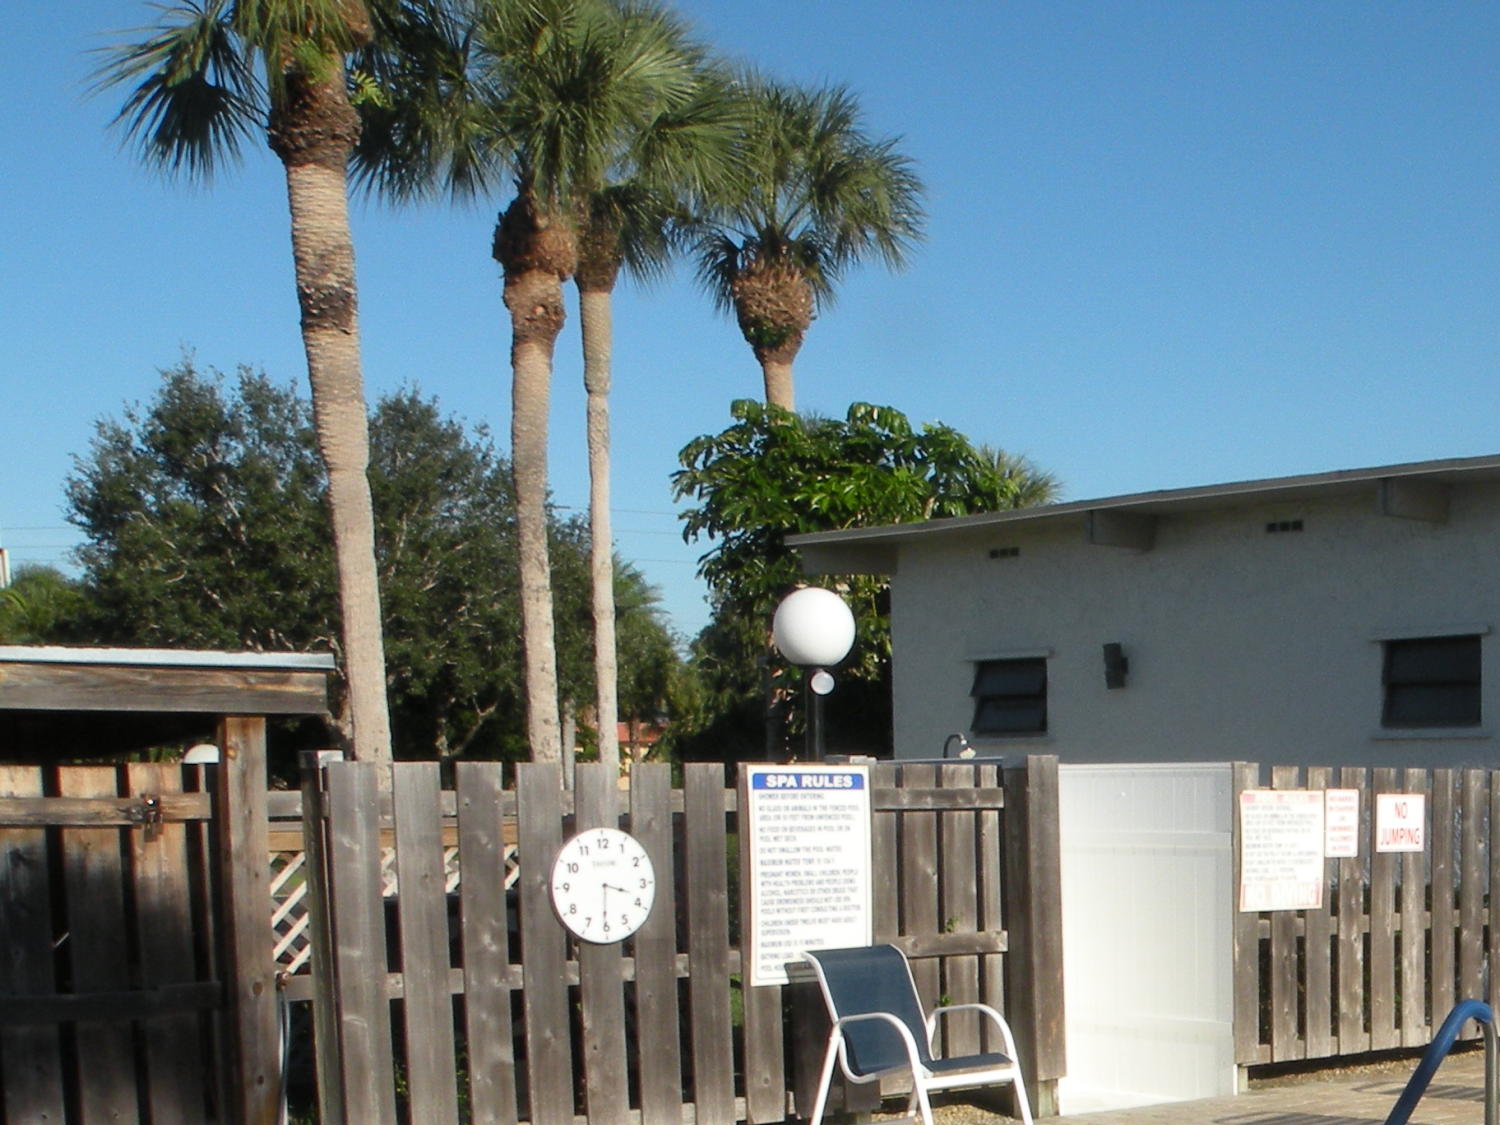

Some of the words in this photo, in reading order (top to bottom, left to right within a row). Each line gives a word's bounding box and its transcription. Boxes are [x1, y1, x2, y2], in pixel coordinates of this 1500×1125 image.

[766, 774, 798, 788] SPA
[802, 774, 853, 788] RULES
[1395, 802, 1408, 819] NO
[1381, 827, 1420, 846] JUMPING
[597, 839, 609, 849] 12
[620, 844, 625, 853] 1
[579, 846, 589, 856] 11
[633, 857, 640, 867] 2
[567, 863, 579, 873] 10
[563, 882, 570, 892] 9
[640, 879, 647, 889] 3
[634, 898, 641, 907] 4
[570, 904, 577, 914] 8
[585, 917, 592, 927] 7
[621, 914, 628, 925] 5
[603, 921, 610, 932] 6
